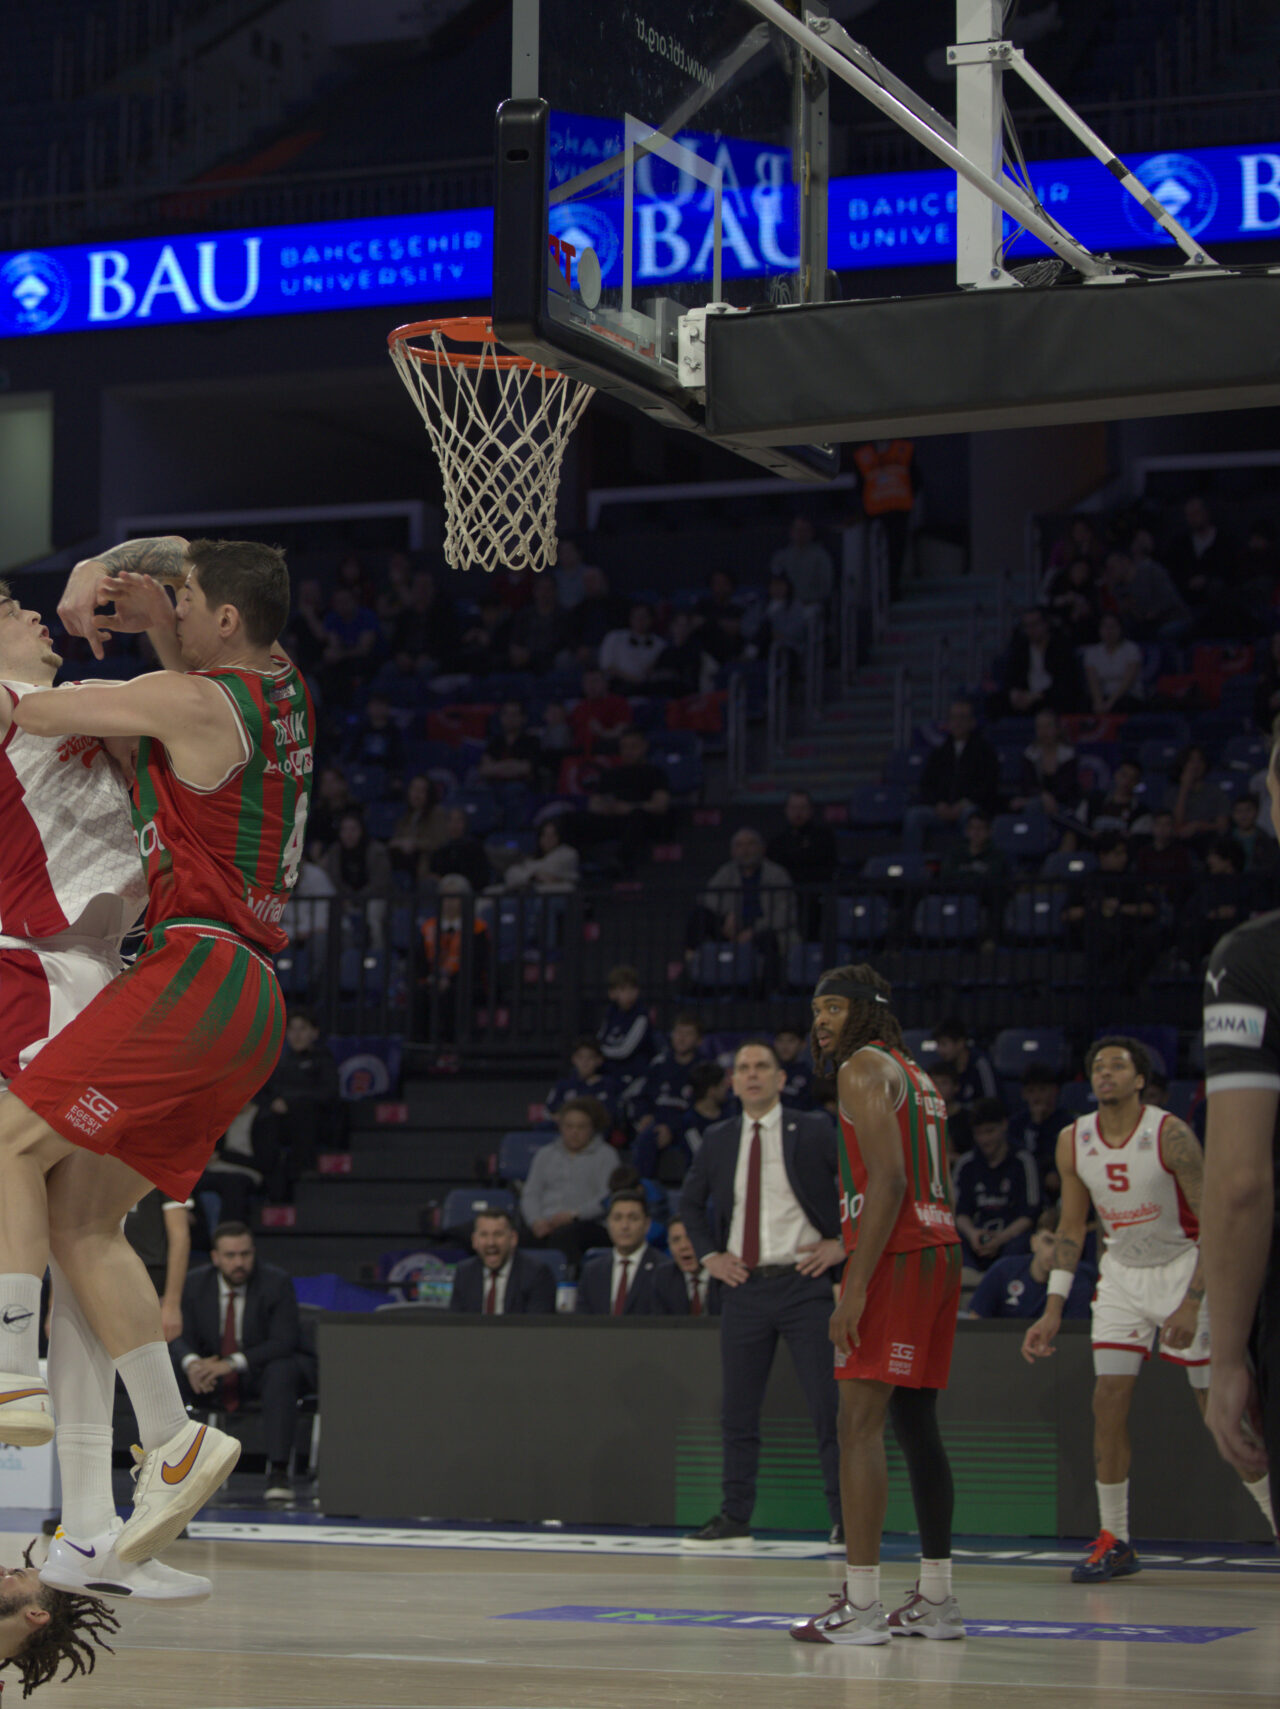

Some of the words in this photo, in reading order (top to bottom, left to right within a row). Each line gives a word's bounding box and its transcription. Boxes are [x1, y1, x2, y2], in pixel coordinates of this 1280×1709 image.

[87, 236, 262, 322] BAU
[279, 261, 463, 296] UNIVERSITY
[1106, 1164, 1129, 1192] 5
